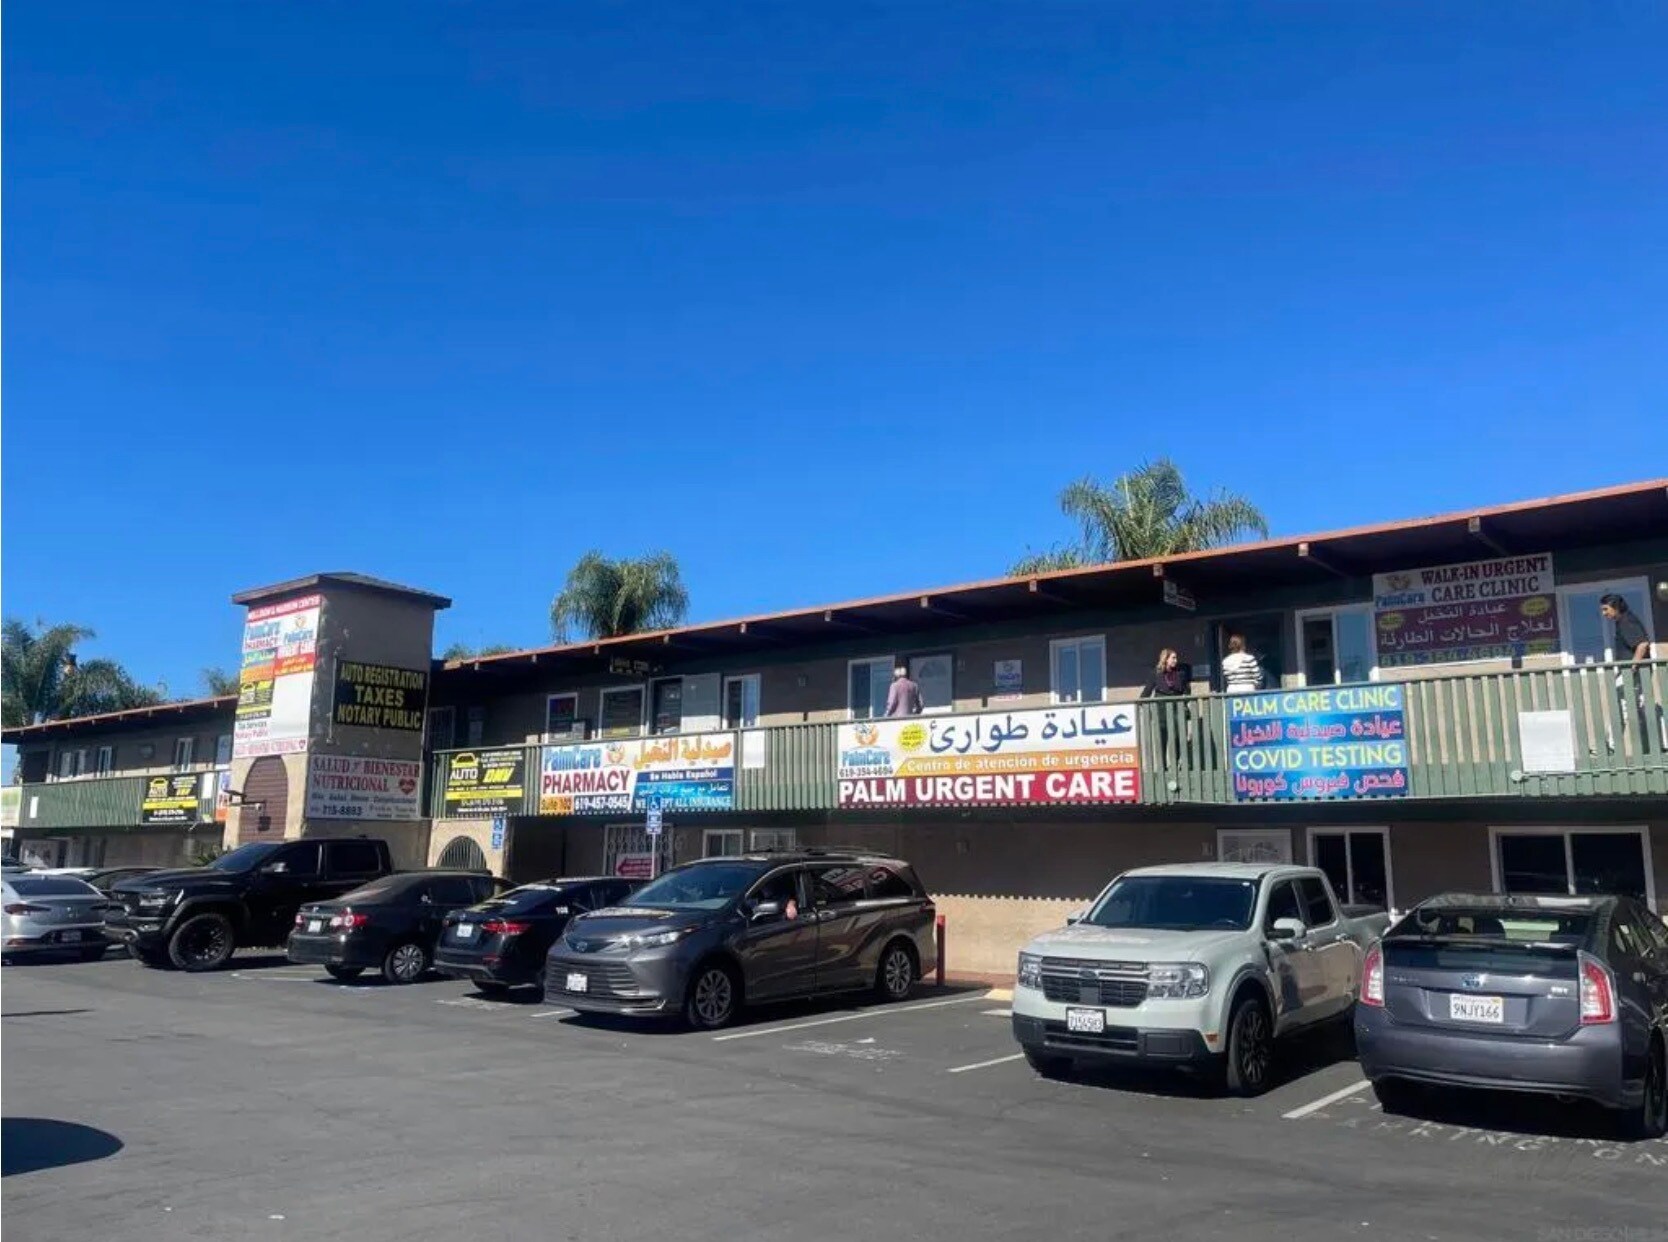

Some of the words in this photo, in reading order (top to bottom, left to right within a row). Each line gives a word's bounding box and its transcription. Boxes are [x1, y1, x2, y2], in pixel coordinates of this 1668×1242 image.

[1422, 567, 1479, 585] WALK-IN
[1483, 556, 1547, 578] URGENT
[1432, 583, 1474, 602] CARE
[1479, 576, 1539, 597] CLINIC
[340, 662, 364, 682] AUTO
[364, 666, 425, 690] REGISTRATION
[354, 685, 405, 707] TAXES
[1233, 698, 1278, 717] PALM
[1283, 692, 1331, 713] CARE
[1336, 686, 1397, 709] CLINIC
[337, 704, 382, 725] NOTARY
[383, 707, 421, 729] PUBLIC
[1041, 709, 1133, 745] عيادة
[1351, 714, 1402, 739] عيادة
[930, 715, 1029, 752] طوارئ
[1233, 720, 1283, 746] النخيل
[1287, 719, 1346, 742] صيدلية
[633, 736, 679, 770] النخيل
[681, 735, 732, 766] صيدلية
[907, 759, 949, 772] Centro
[955, 759, 971, 771] de
[1042, 754, 1060, 767] de
[1065, 752, 1135, 768] urgencia
[1235, 748, 1302, 770] COVID
[1309, 743, 1402, 768] TESTING
[313, 757, 350, 773] SALUD
[450, 768, 478, 781] AUTO
[661, 770, 684, 780] Habla
[313, 773, 388, 793] NUTRICIONAL
[543, 769, 630, 794] PHARMACY
[839, 779, 905, 803] PALM
[916, 775, 1036, 801] URGENT
[1046, 770, 1135, 799] CARE
[1236, 772, 1288, 796] كورونا
[1292, 771, 1349, 795] فيروس
[1353, 769, 1405, 793] فحص
[1453, 1003, 1500, 1018] 9NJY166
